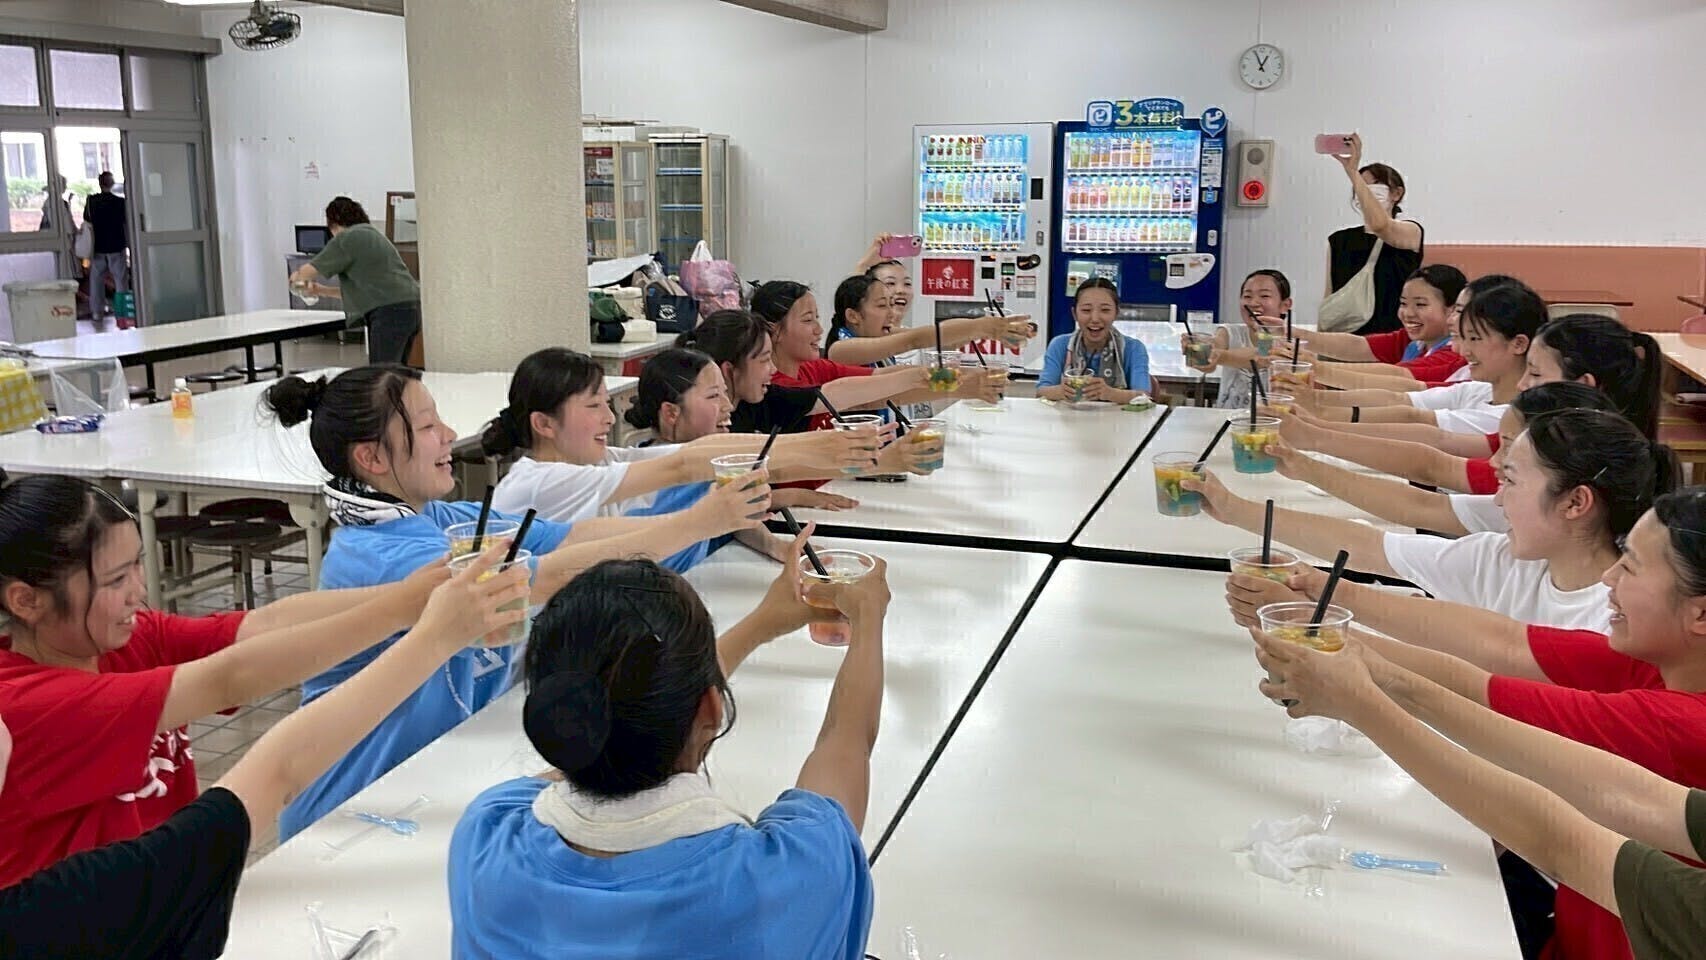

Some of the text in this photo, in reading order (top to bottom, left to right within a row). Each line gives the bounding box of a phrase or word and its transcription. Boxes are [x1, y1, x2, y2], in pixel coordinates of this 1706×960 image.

[927, 278, 970, 289] 午後の紅茶
